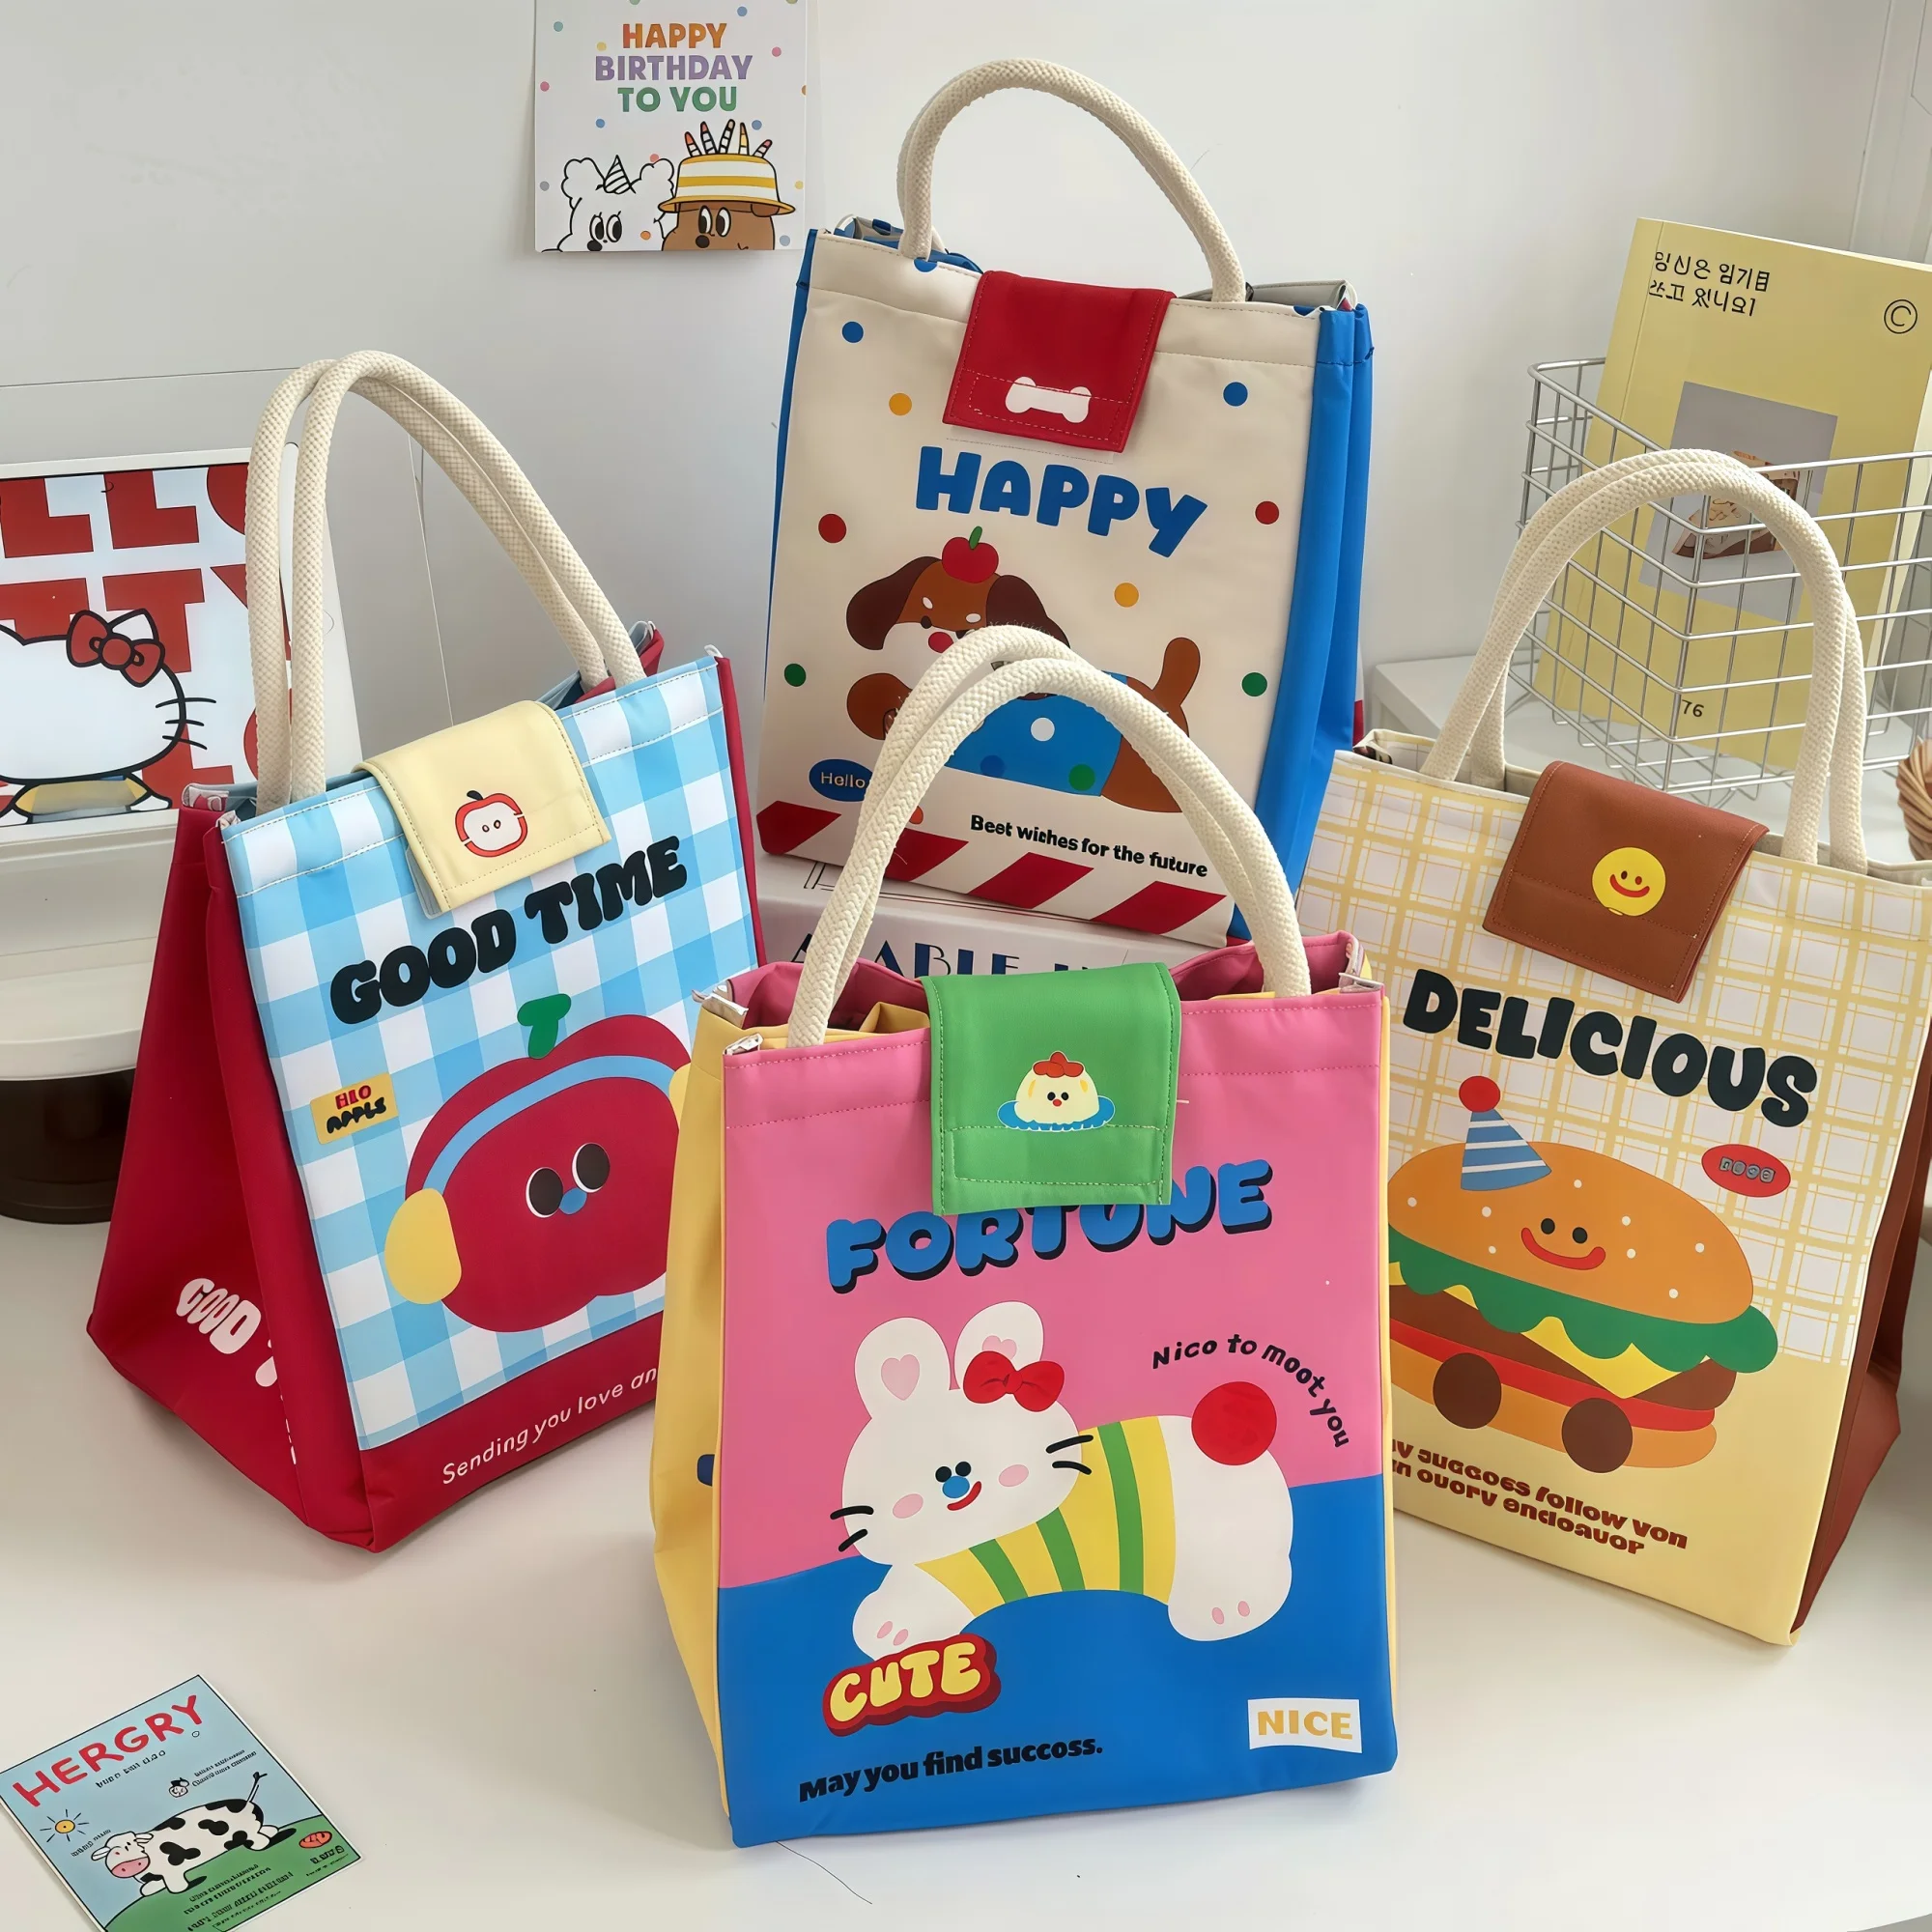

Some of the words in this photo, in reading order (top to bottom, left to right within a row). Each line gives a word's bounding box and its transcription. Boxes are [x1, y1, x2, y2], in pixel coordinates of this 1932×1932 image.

[595, 54, 753, 81] BIRTHDAY
[622, 23, 727, 49] HAPPY
[617, 87, 661, 112] TO
[916, 445, 1208, 558] HAPPY
[1682, 698, 1705, 718] 76
[820, 771, 867, 788] Hello
[1081, 838, 1110, 857] for
[1113, 845, 1146, 865] the
[1149, 852, 1208, 878] future
[330, 909, 517, 1025] GOOD
[524, 836, 688, 945] TIME
[1403, 968, 1818, 1128] DELICIOUS
[826, 1159, 1273, 1294] FORTUNE
[176, 1278, 262, 1354] GOOD
[1227, 1334, 1258, 1354] to
[1309, 1398, 1350, 1448] you
[442, 1429, 529, 1484] Sending
[532, 1406, 571, 1443] you
[578, 1383, 623, 1414] love
[830, 1641, 981, 1722] CUTE
[12, 1694, 203, 1807] HERGRY
[1258, 1710, 1352, 1740] NICE
[799, 1770, 862, 1803] May
[864, 1761, 919, 1793] you
[923, 1746, 982, 1776] find
